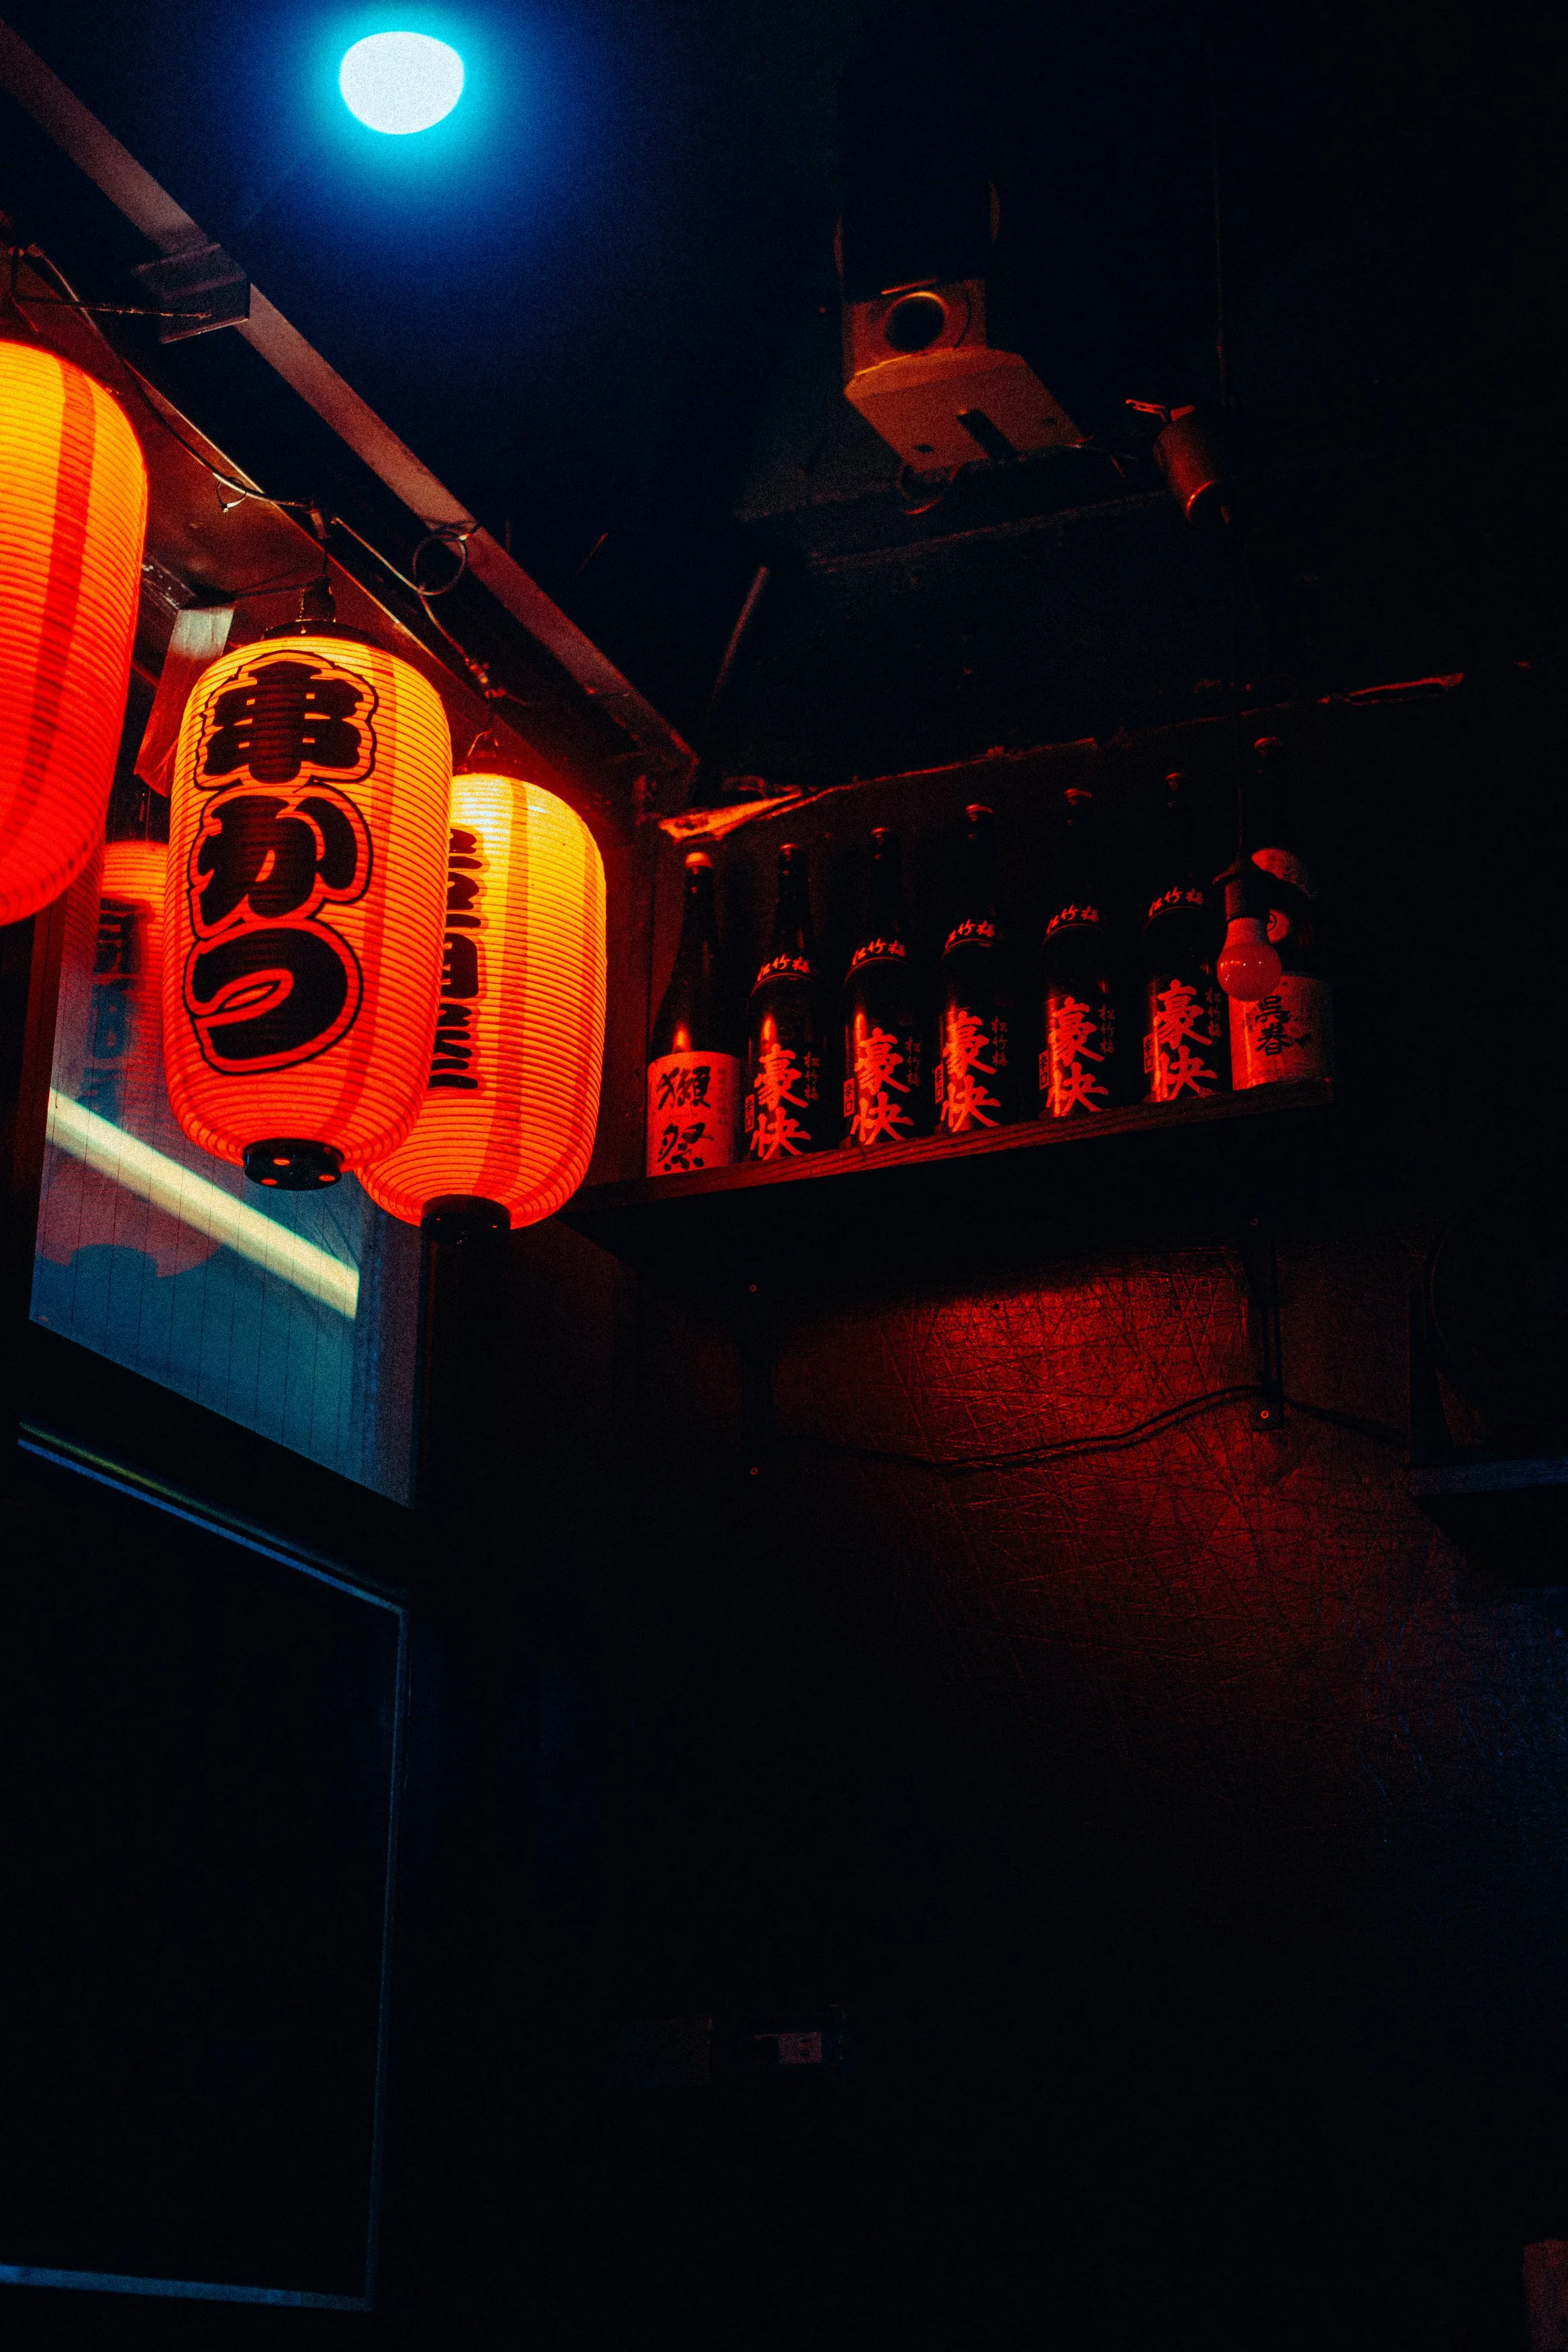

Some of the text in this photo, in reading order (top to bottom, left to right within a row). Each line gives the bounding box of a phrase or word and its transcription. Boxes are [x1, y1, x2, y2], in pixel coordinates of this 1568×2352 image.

[191, 659, 365, 1062] 串かつ
[941, 1010, 1001, 1132] 豪快
[1045, 996, 1110, 1118] 豪快
[1153, 978, 1218, 1102] 豪快
[1255, 995, 1289, 1055] 呉春
[656, 1065, 713, 1171] 獺祭
[750, 1043, 812, 1162] 豪快
[849, 1026, 914, 1146] 豪快
